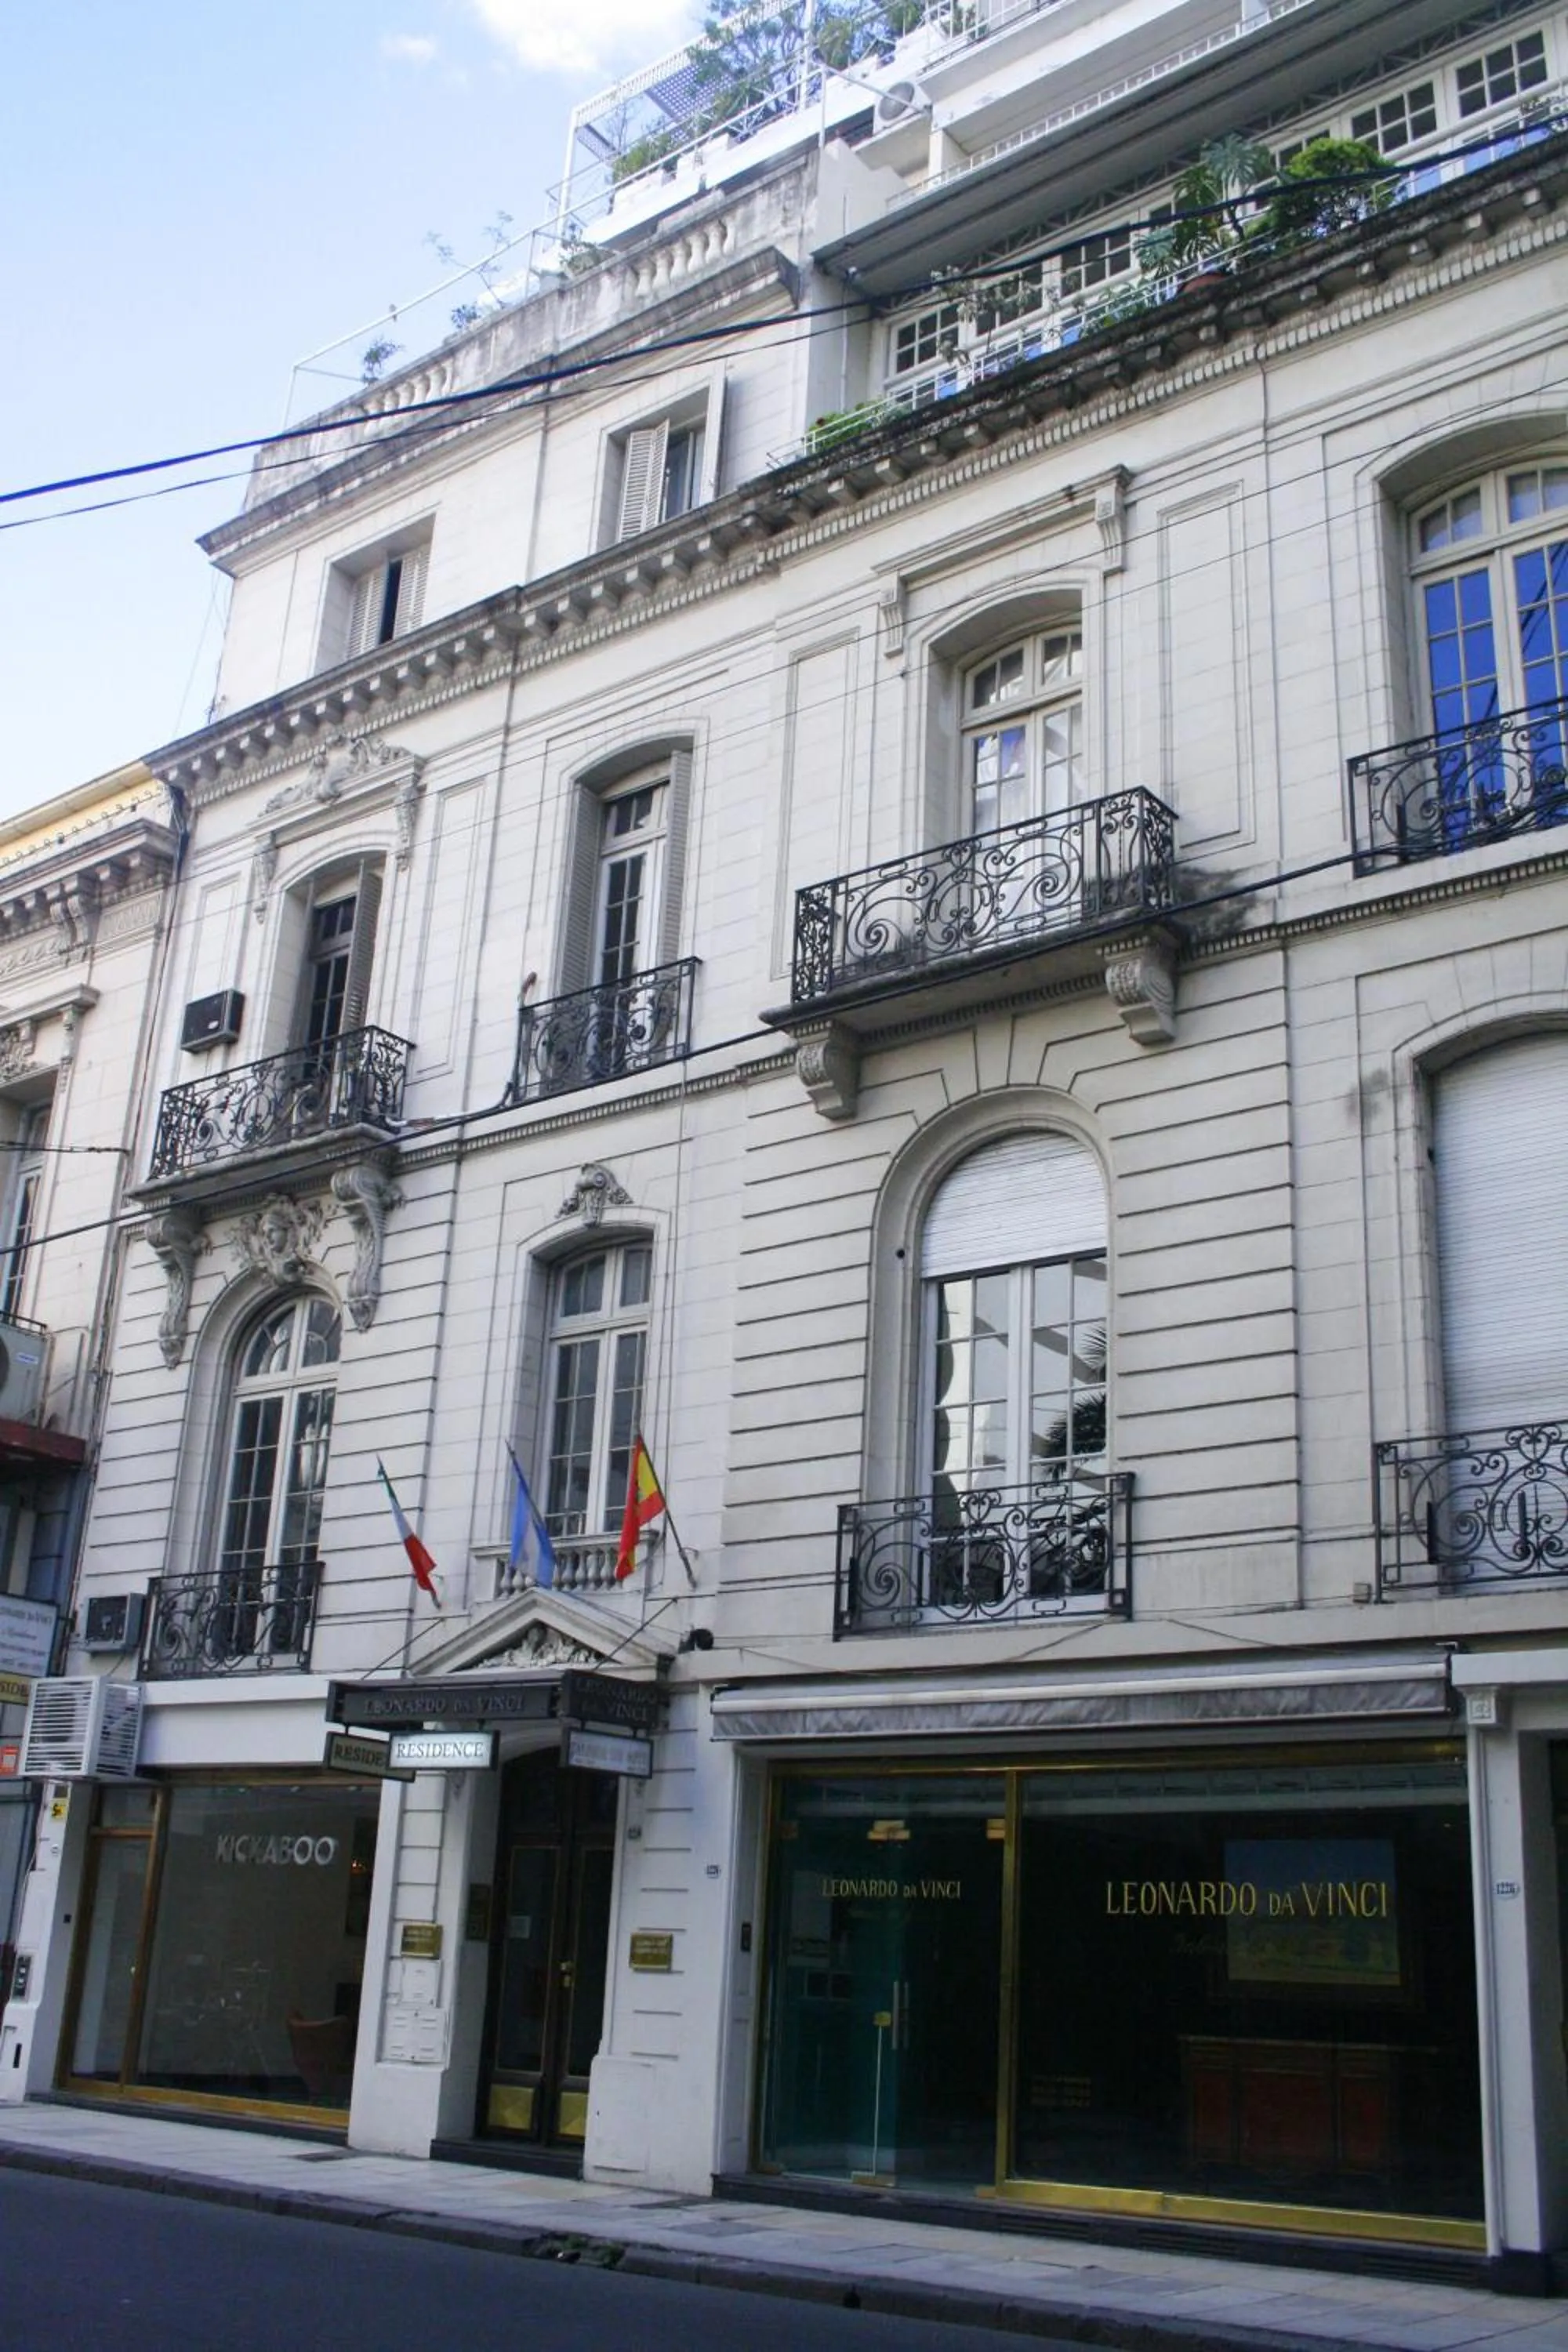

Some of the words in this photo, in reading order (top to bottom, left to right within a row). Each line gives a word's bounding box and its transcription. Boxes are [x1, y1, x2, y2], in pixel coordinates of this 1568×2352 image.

[364, 1697, 446, 1715] LEONARDO
[477, 1693, 525, 1713] VINCI
[397, 1741, 485, 1759] RESIDENCE
[216, 1834, 338, 1865] KICKABOO
[822, 1878, 898, 1897] LEONARDO
[920, 1879, 961, 1899] VINCI
[1105, 1881, 1257, 1916] LEONARDO
[1269, 1893, 1295, 1917] DA
[1301, 1881, 1387, 1918] VINCI
